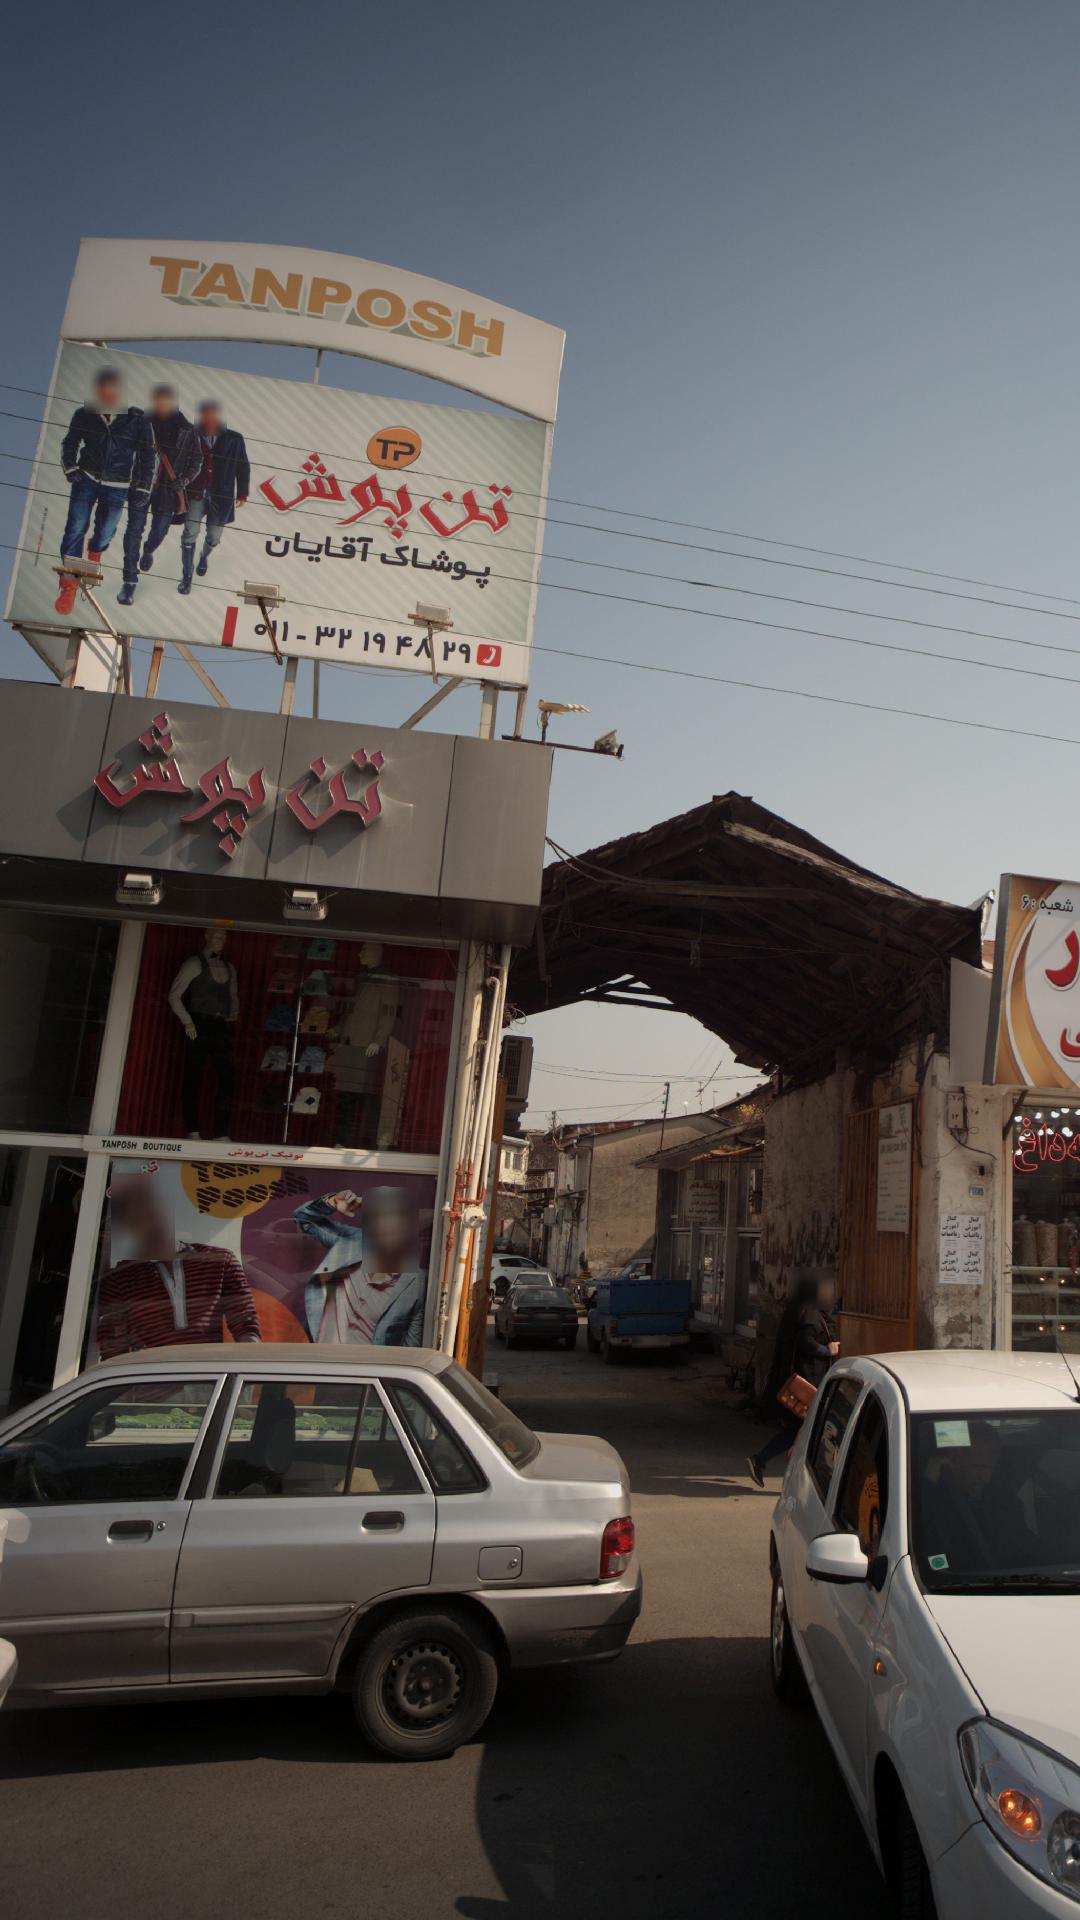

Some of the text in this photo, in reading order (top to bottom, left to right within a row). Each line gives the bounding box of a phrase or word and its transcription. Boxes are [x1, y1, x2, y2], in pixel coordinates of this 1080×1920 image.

[149, 255, 505, 357] TANPOSH
[376, 438, 416, 461] TP
[259, 452, 513, 540] تن پوش
[265, 532, 491, 589] پوشاک آقایان
[94, 712, 385, 860] تن پوش
[101, 1139, 182, 1152] TANPOSH BOUTIQUE
